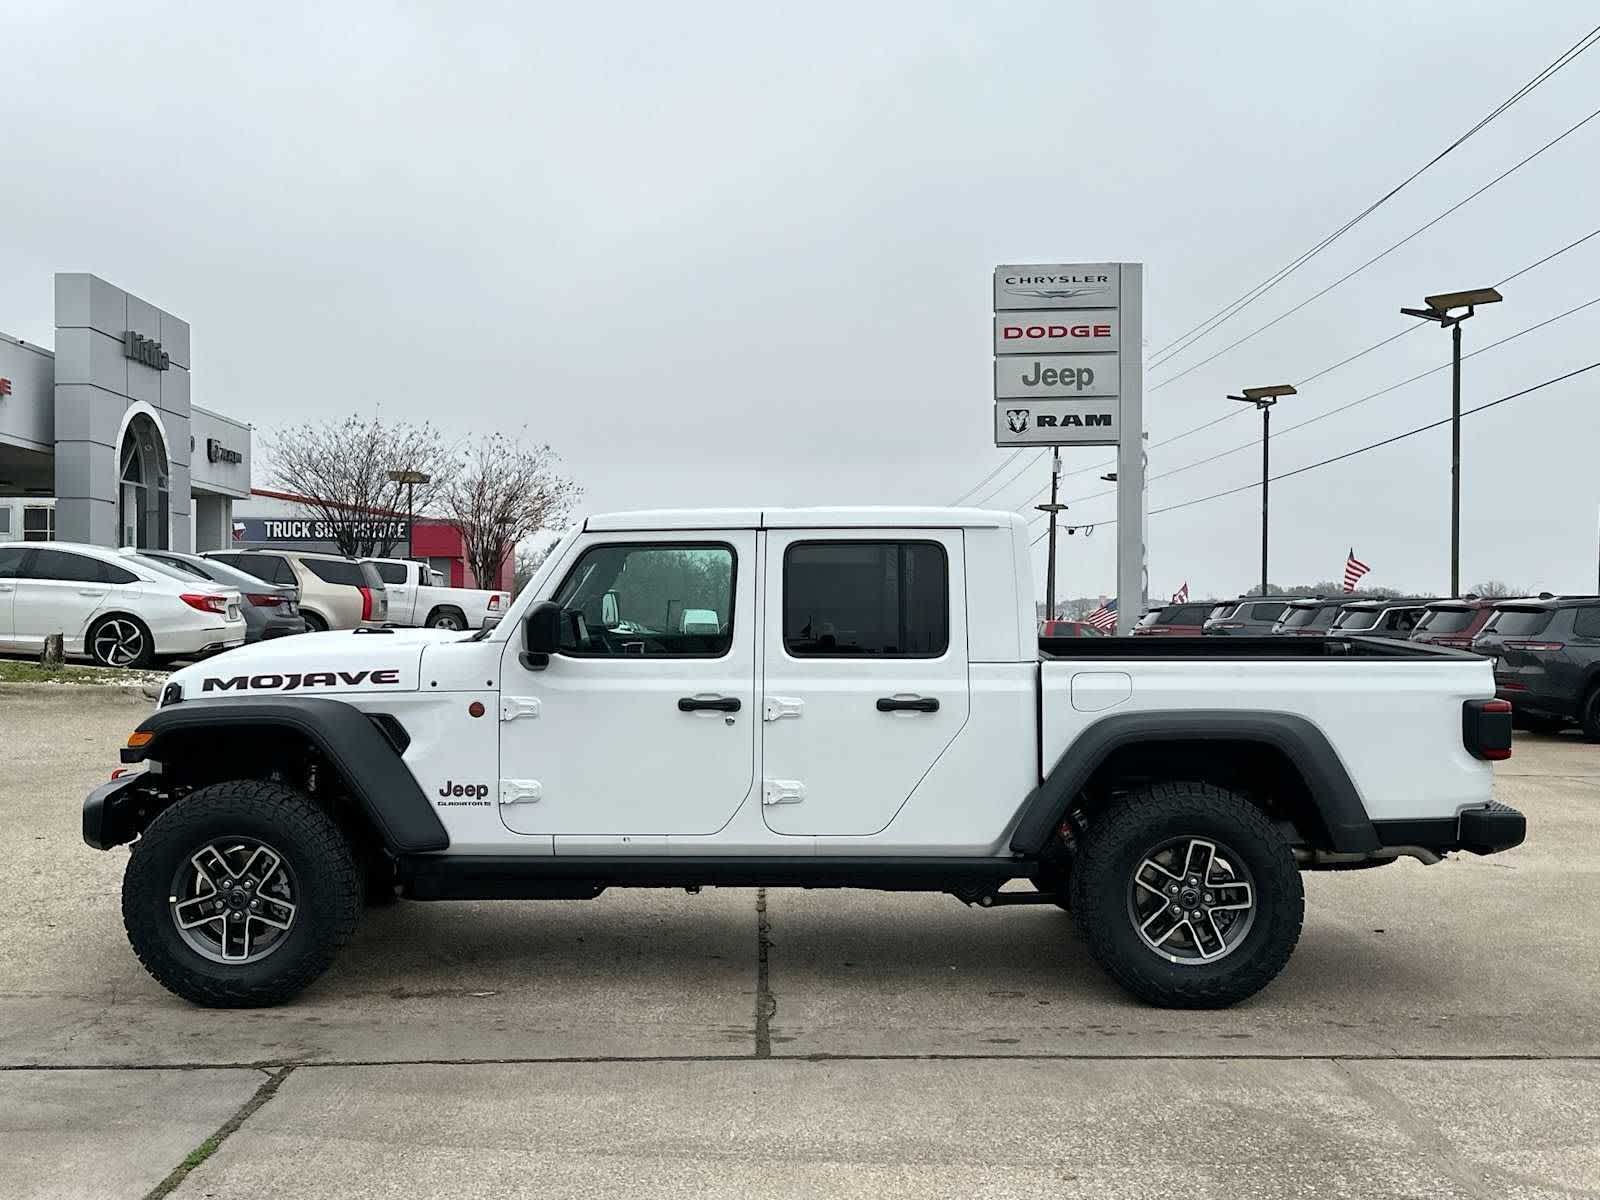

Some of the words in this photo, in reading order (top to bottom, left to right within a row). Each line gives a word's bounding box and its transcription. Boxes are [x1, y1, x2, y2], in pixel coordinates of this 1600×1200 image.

[1005, 275, 1108, 285] CHRYSLER
[1004, 325, 1112, 340] DODGE
[1022, 362, 1094, 391] Jeep
[1037, 414, 1112, 427] RAM
[264, 521, 311, 538] TRUCK
[202, 669, 399, 692] MOJAVE
[439, 780, 489, 800] Jeep
